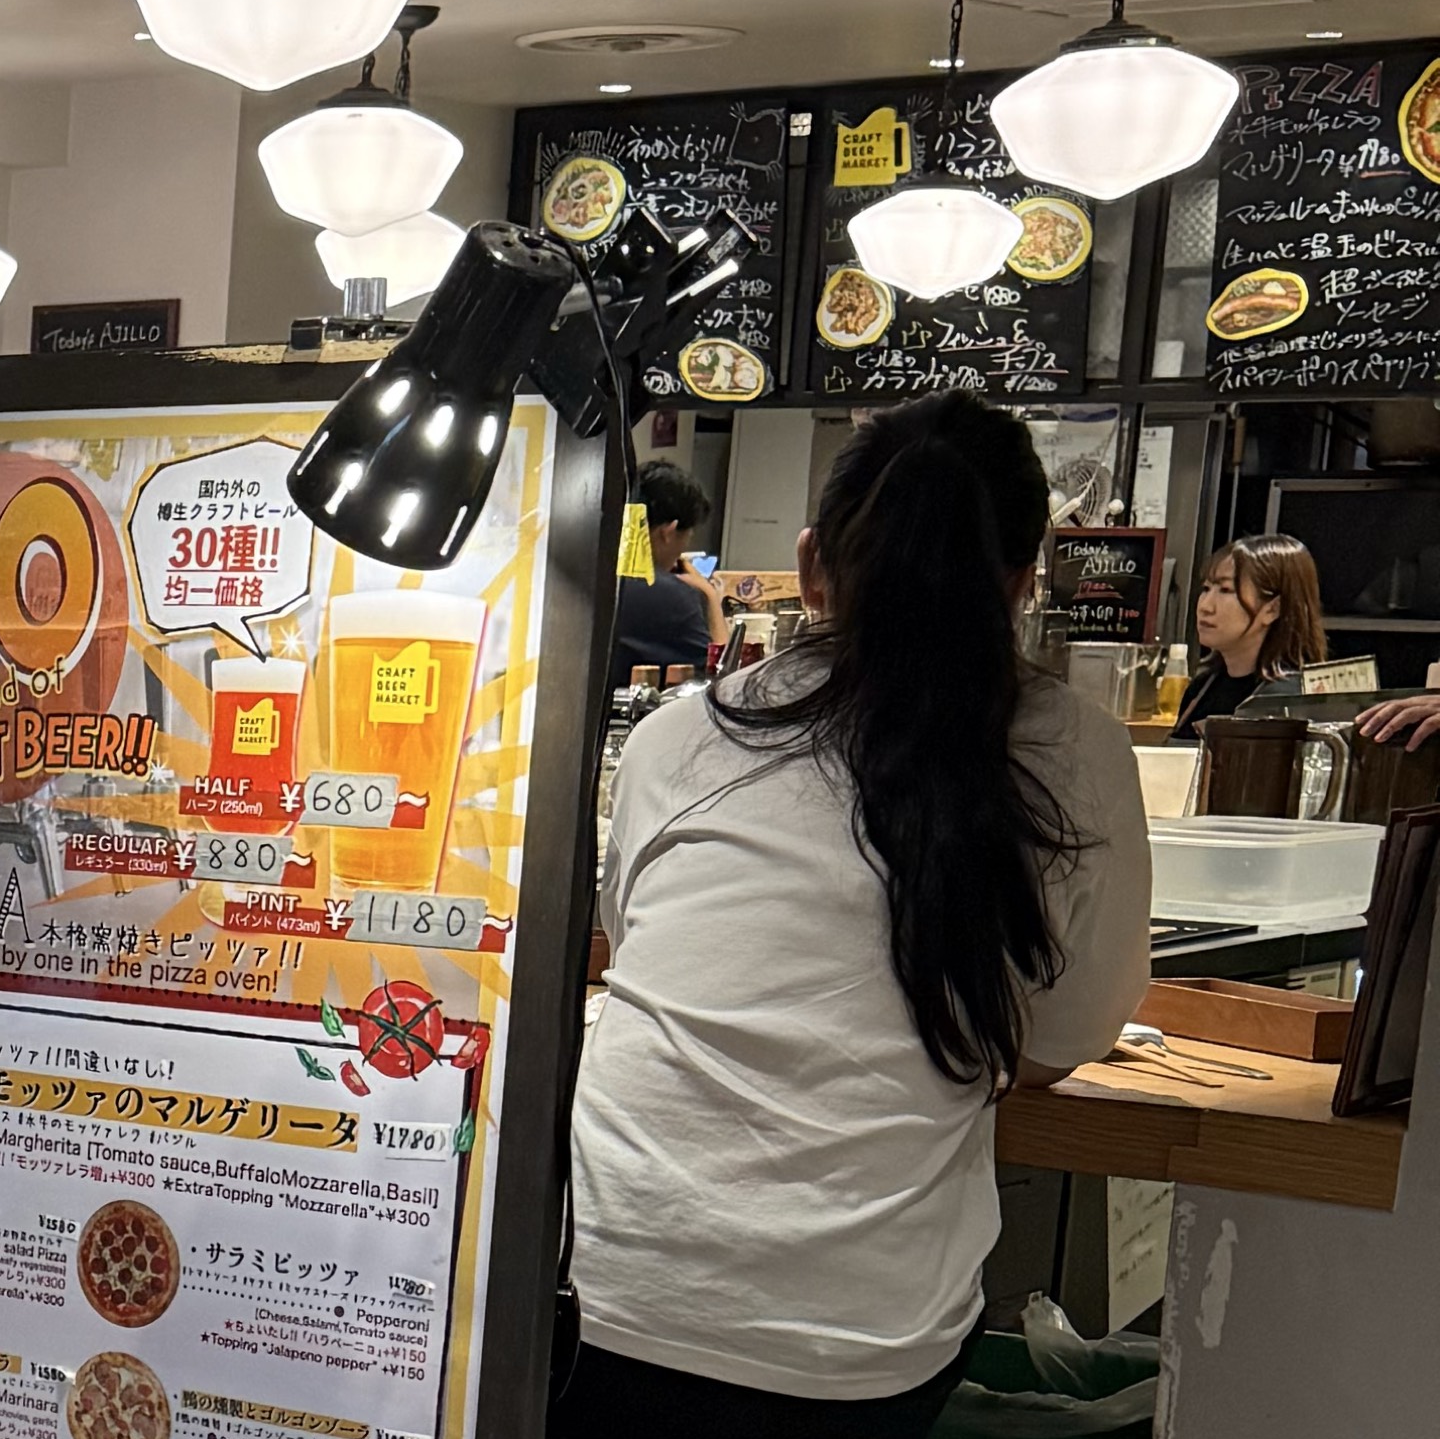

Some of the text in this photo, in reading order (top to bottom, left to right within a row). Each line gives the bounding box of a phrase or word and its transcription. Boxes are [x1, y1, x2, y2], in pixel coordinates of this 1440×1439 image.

[1234, 61, 1383, 114] PIZZA
[843, 133, 882, 144] CRAFT
[843, 146, 874, 156] BEER
[842, 158, 889, 168] MARKET
[198, 479, 260, 498] 国内外の
[164, 575, 263, 606] 均一価格
[31, 657, 65, 695] of
[377, 667, 415, 679] CRAFT
[377, 681, 406, 692] BEER
[376, 693, 420, 706] MARKET
[194, 779, 250, 797] HALF
[72, 834, 168, 856] REGULAR
[246, 893, 301, 913] PINT
[2, 948, 26, 970] by
[34, 952, 73, 970] one
[80, 953, 99, 975] in
[107, 955, 143, 979] the
[150, 963, 206, 986] pizza
[215, 968, 278, 993] oven!
[357, 1308, 430, 1332] Pepperoni
